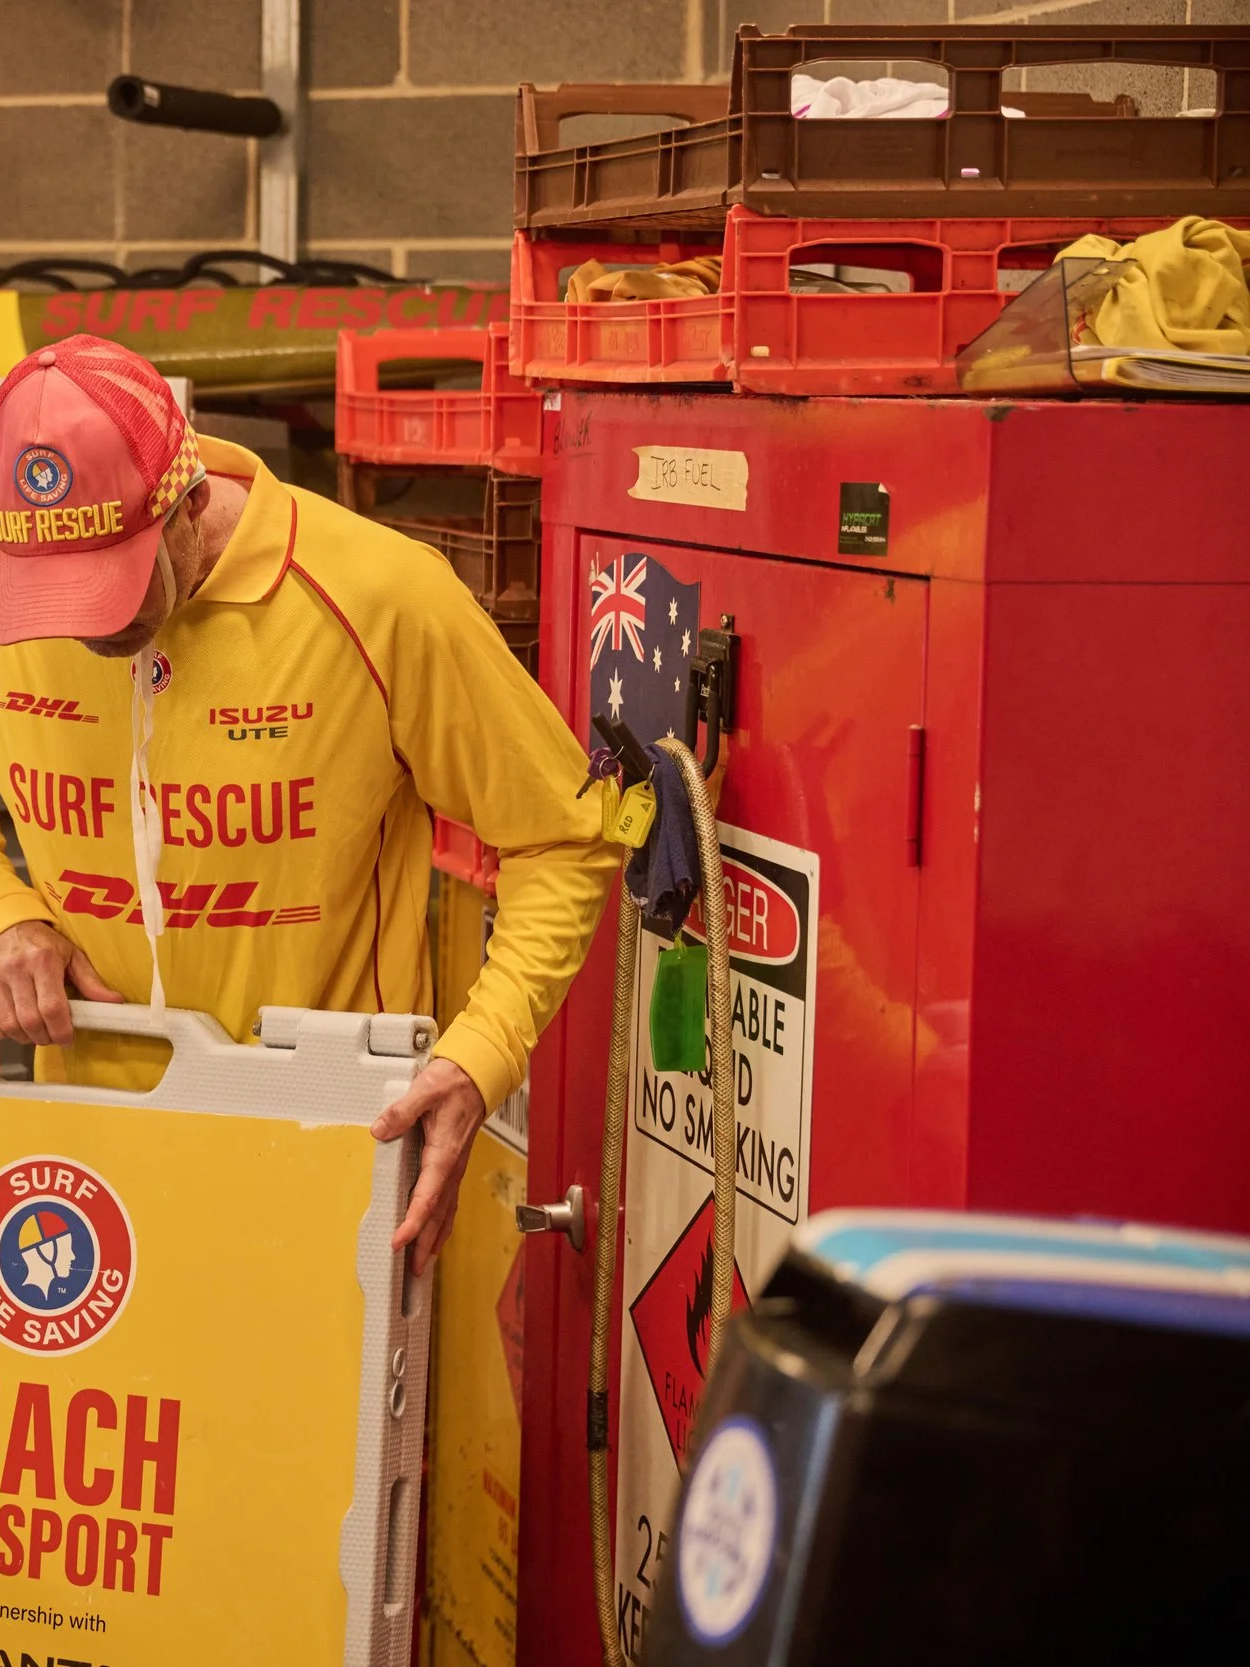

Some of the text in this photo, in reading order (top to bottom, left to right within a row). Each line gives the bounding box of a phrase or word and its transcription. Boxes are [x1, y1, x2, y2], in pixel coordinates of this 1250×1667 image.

[40, 288, 224, 337] SURF
[25, 448, 55, 461] SURF
[20, 473, 68, 502] LIFE SAVING
[650, 455, 721, 491] IRB FUEL
[35, 500, 124, 543] RESCUE
[152, 673, 171, 694] AVING
[4, 691, 85, 722] DHL
[209, 702, 314, 725] ISUZU
[227, 726, 289, 741] UTE
[9, 762, 115, 839] SURF
[619, 815, 634, 835] RED
[58, 868, 276, 929] DHL
[643, 1065, 796, 1203] NO SMKING
[9, 1166, 99, 1200] SURF
[22, 1268, 124, 1345] SAVING
[69, 1613, 107, 1633] with
